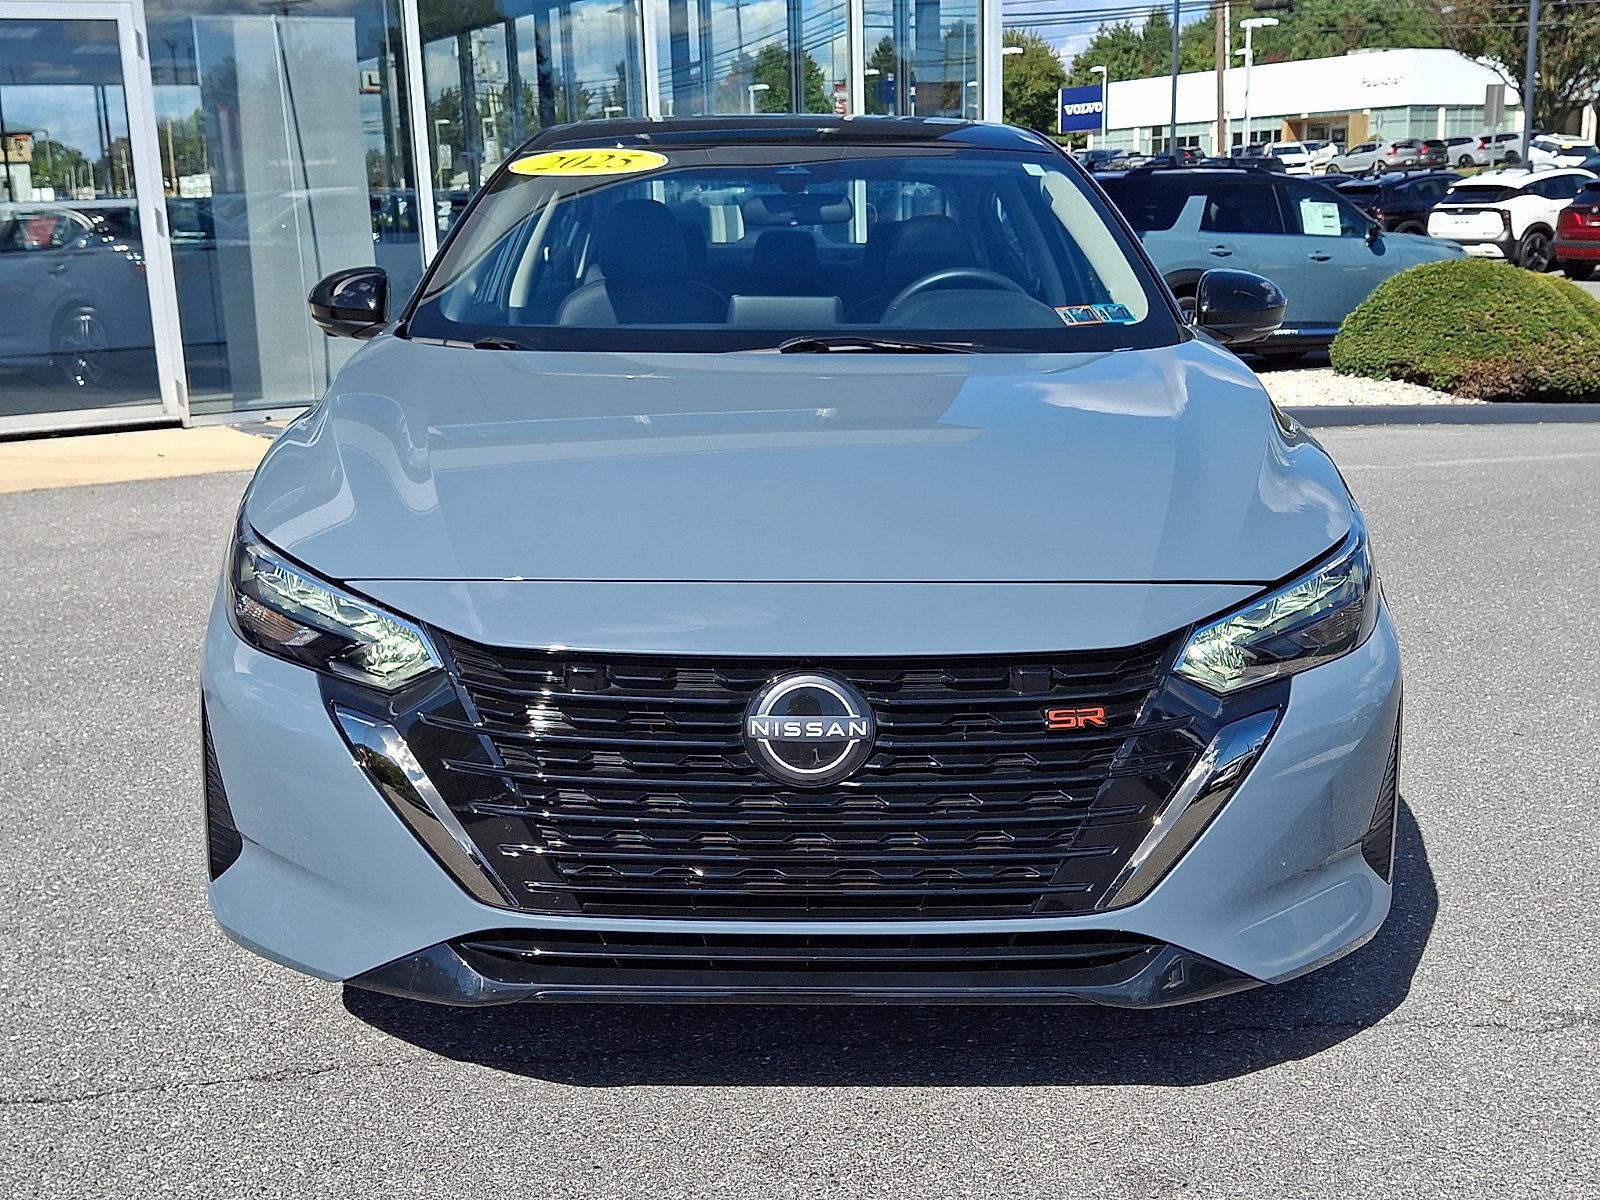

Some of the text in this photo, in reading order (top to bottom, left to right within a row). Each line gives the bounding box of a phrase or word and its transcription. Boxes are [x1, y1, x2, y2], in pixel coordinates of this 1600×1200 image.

[1063, 101, 1103, 116] VOLVO
[530, 153, 643, 171] 2025
[1047, 706, 1107, 729] SR
[751, 720, 867, 737] NISSAN
